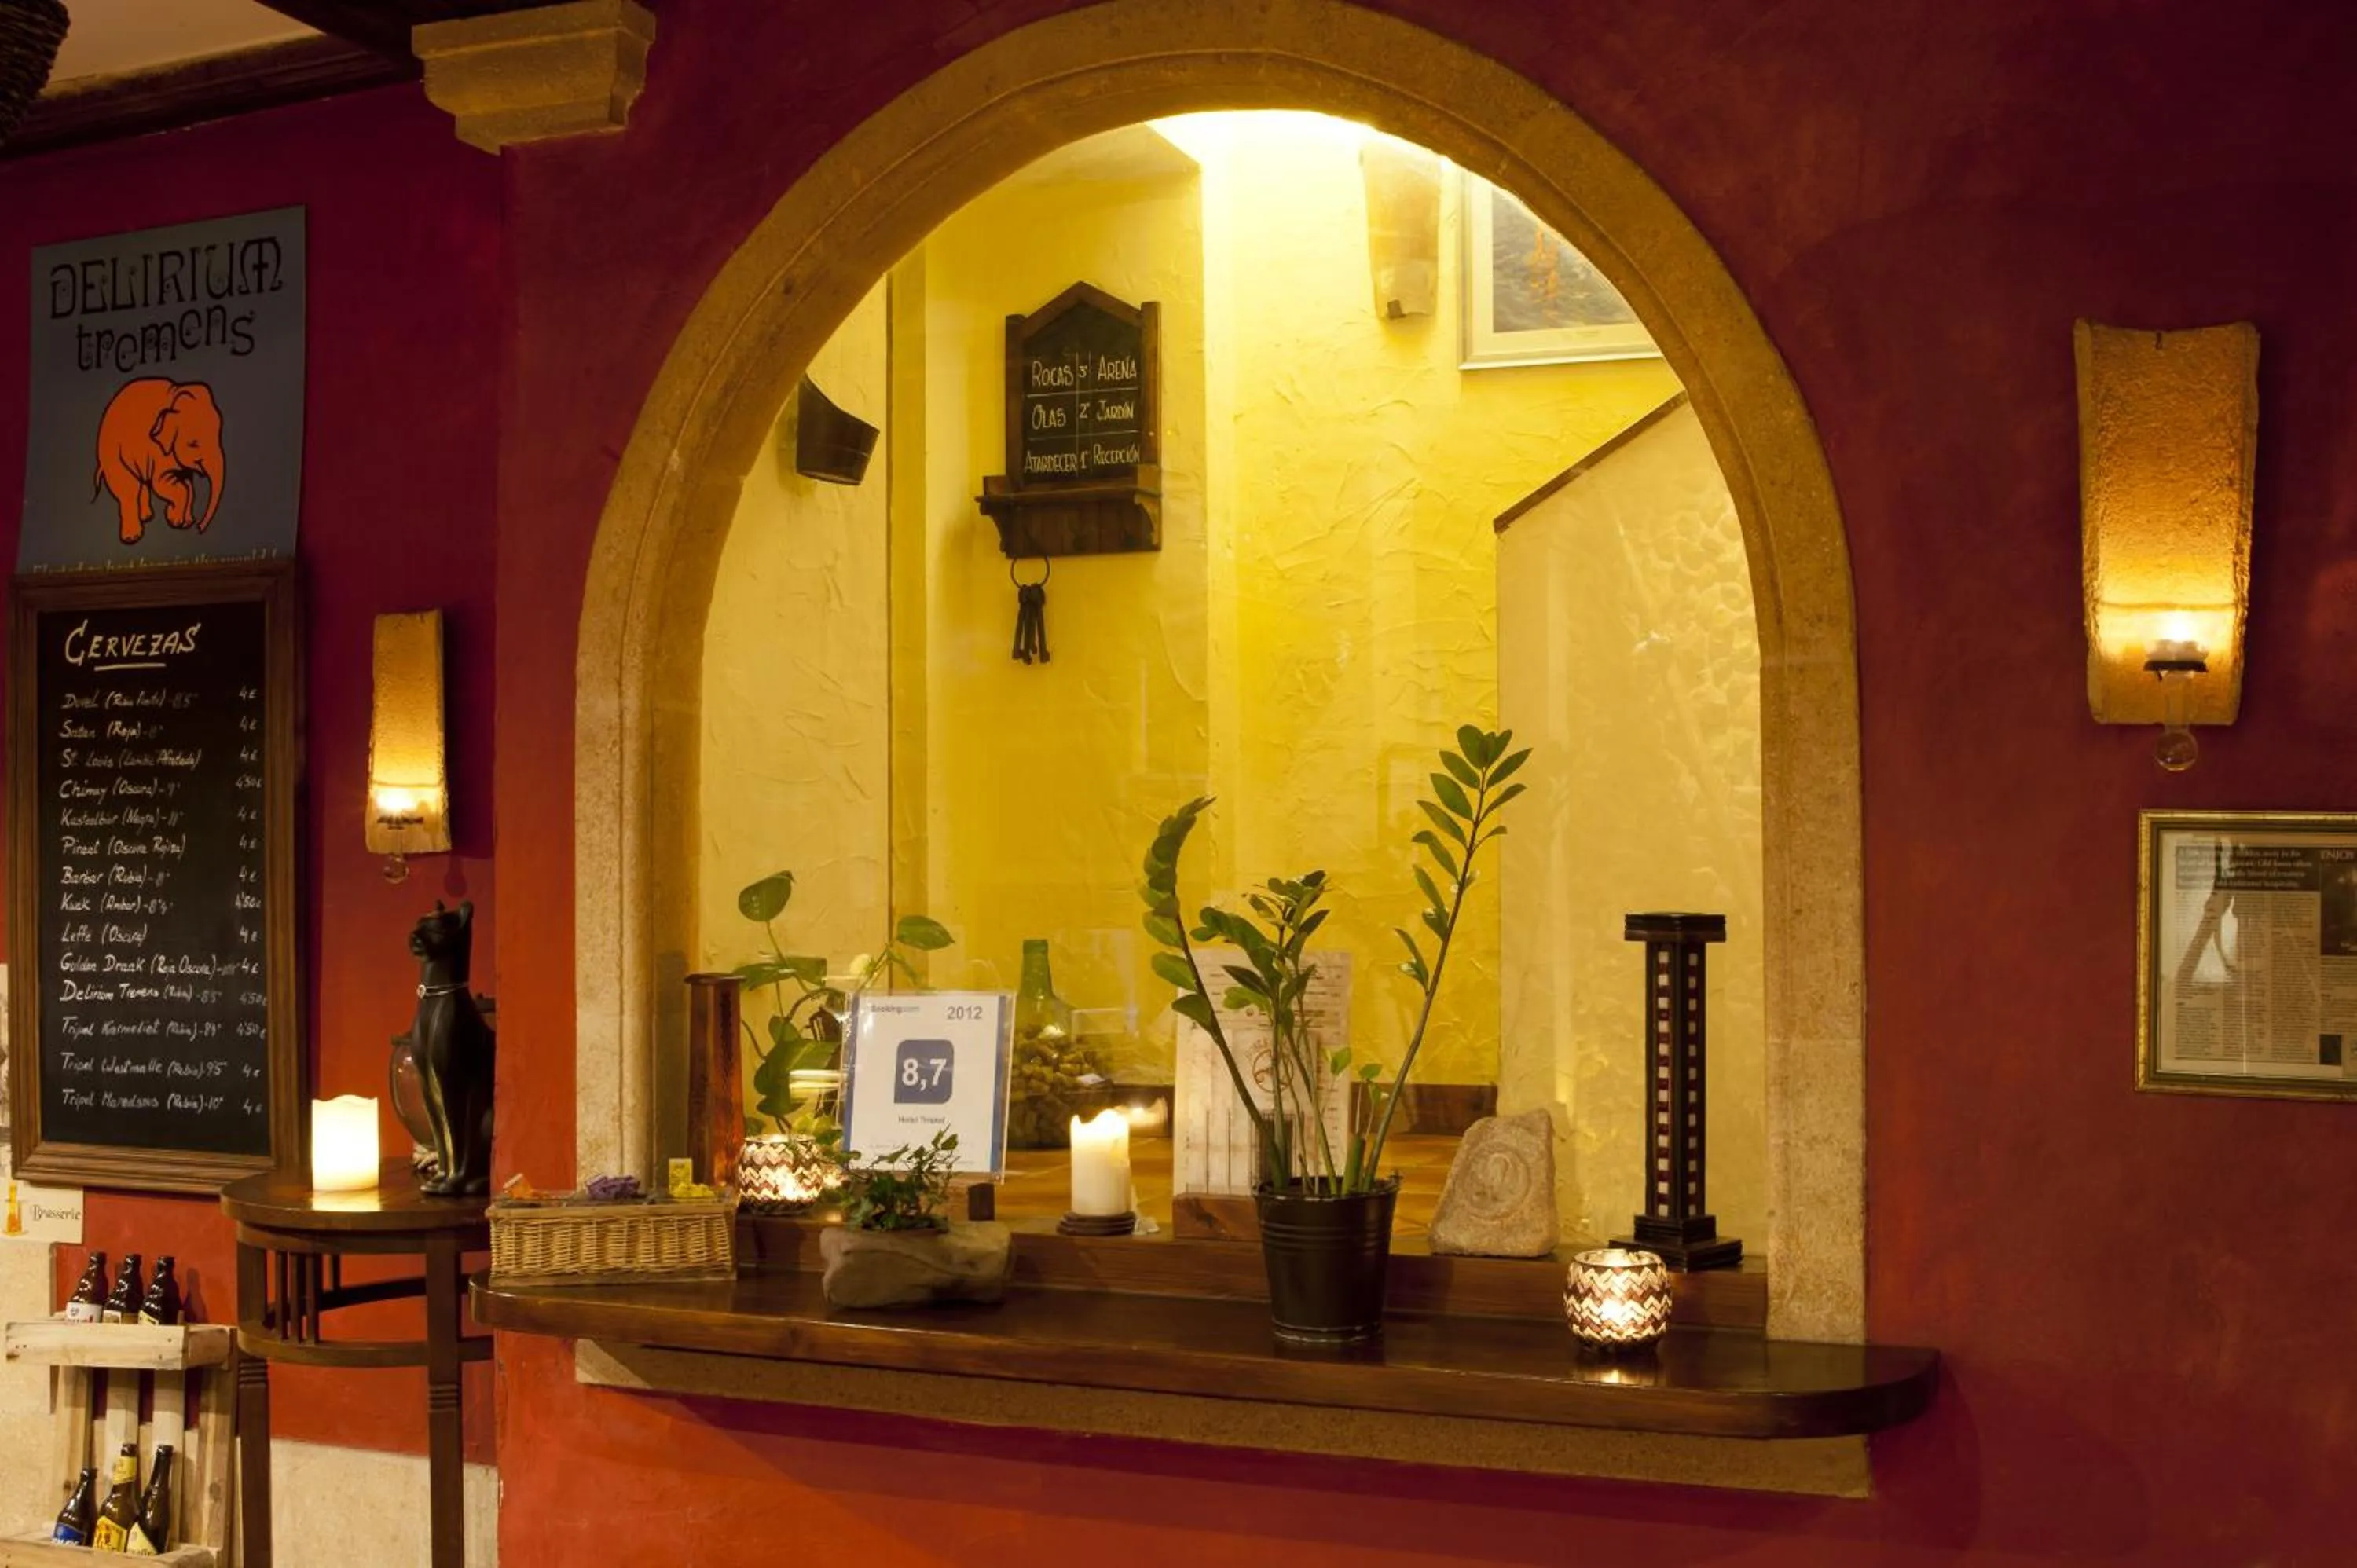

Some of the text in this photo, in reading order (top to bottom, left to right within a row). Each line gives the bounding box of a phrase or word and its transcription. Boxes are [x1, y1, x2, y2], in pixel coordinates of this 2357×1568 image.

[50, 237, 283, 319] DELIRIUM
[75, 305, 257, 373] tremens
[1032, 404, 1067, 430] OLAS
[947, 1006, 984, 1020] 2012
[902, 1057, 947, 1091] 8,7
